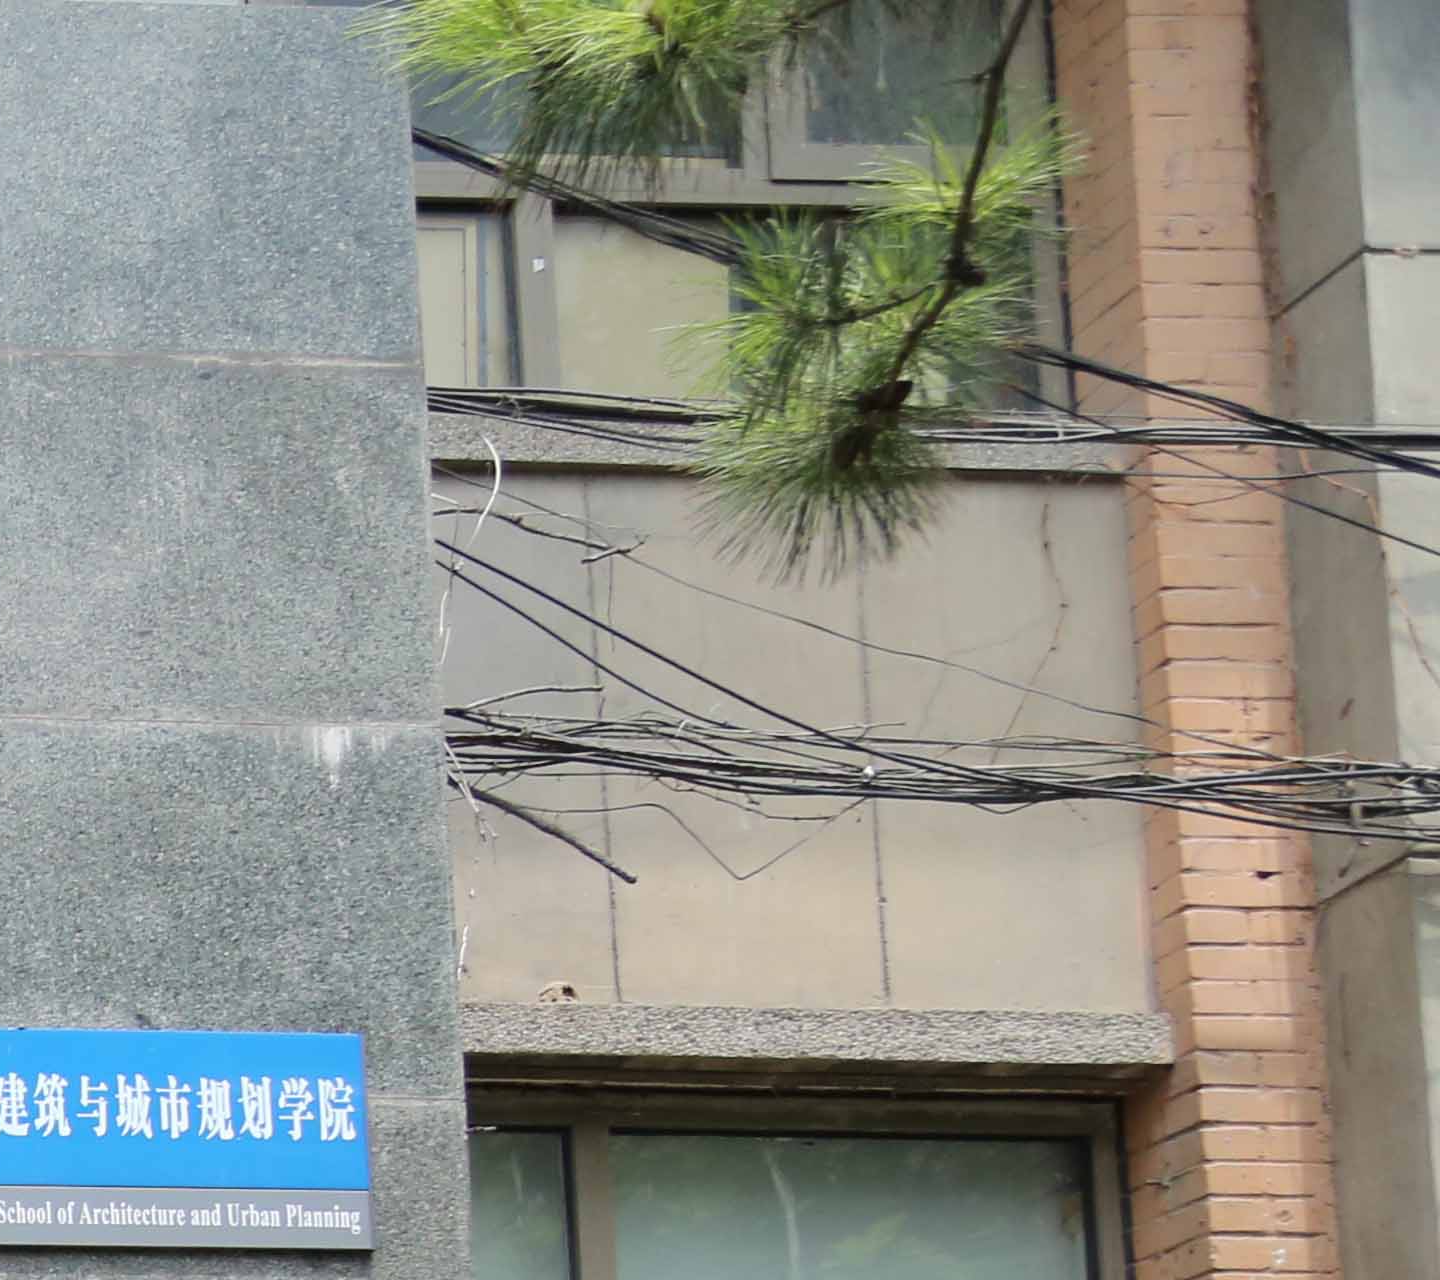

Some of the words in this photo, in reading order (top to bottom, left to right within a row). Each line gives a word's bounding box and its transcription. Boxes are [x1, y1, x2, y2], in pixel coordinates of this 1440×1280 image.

[57, 1201, 77, 1225] of
[79, 1201, 186, 1227] Architecture
[190, 1203, 222, 1228] and
[226, 1203, 280, 1228] Urban
[285, 1203, 361, 1234] Planning
